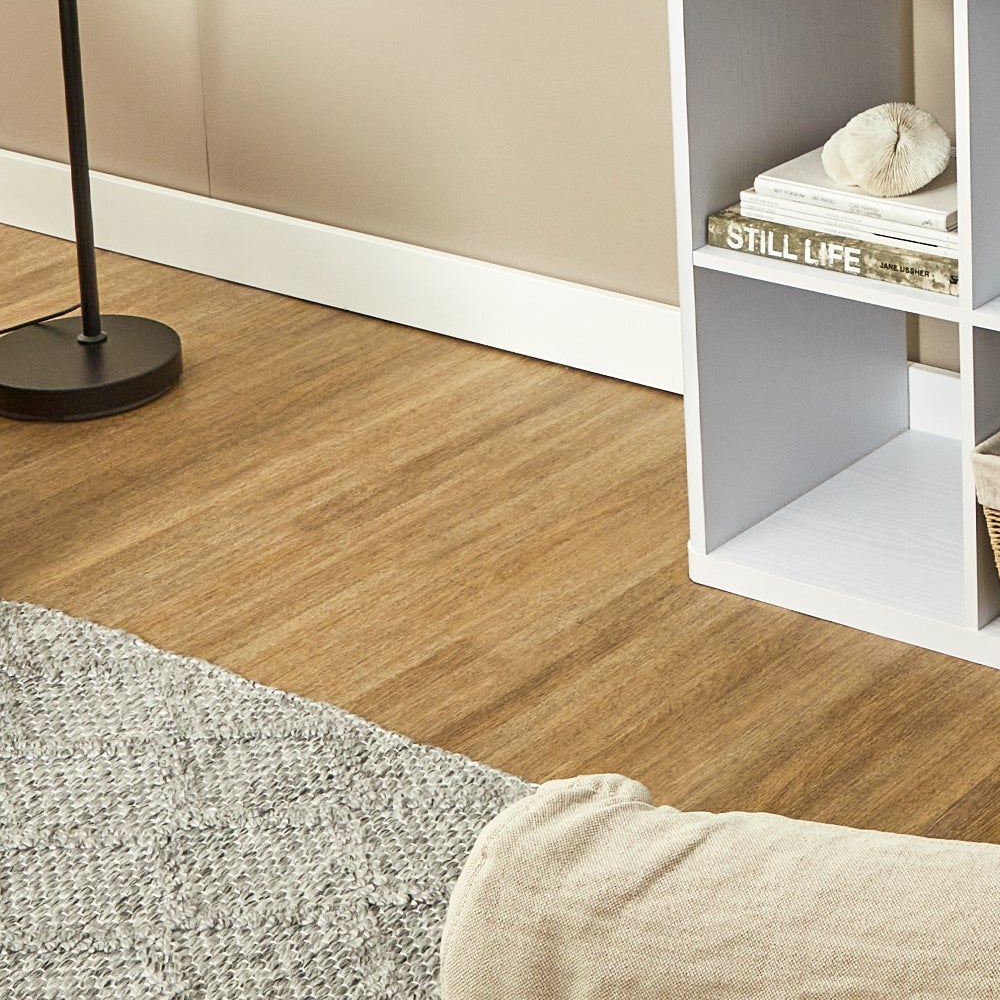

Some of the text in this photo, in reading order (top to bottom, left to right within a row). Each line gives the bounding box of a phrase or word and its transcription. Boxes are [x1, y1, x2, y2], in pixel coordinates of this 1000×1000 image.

[725, 222, 861, 275] STILL LIFE
[879, 262, 930, 277] JANE USSHER
